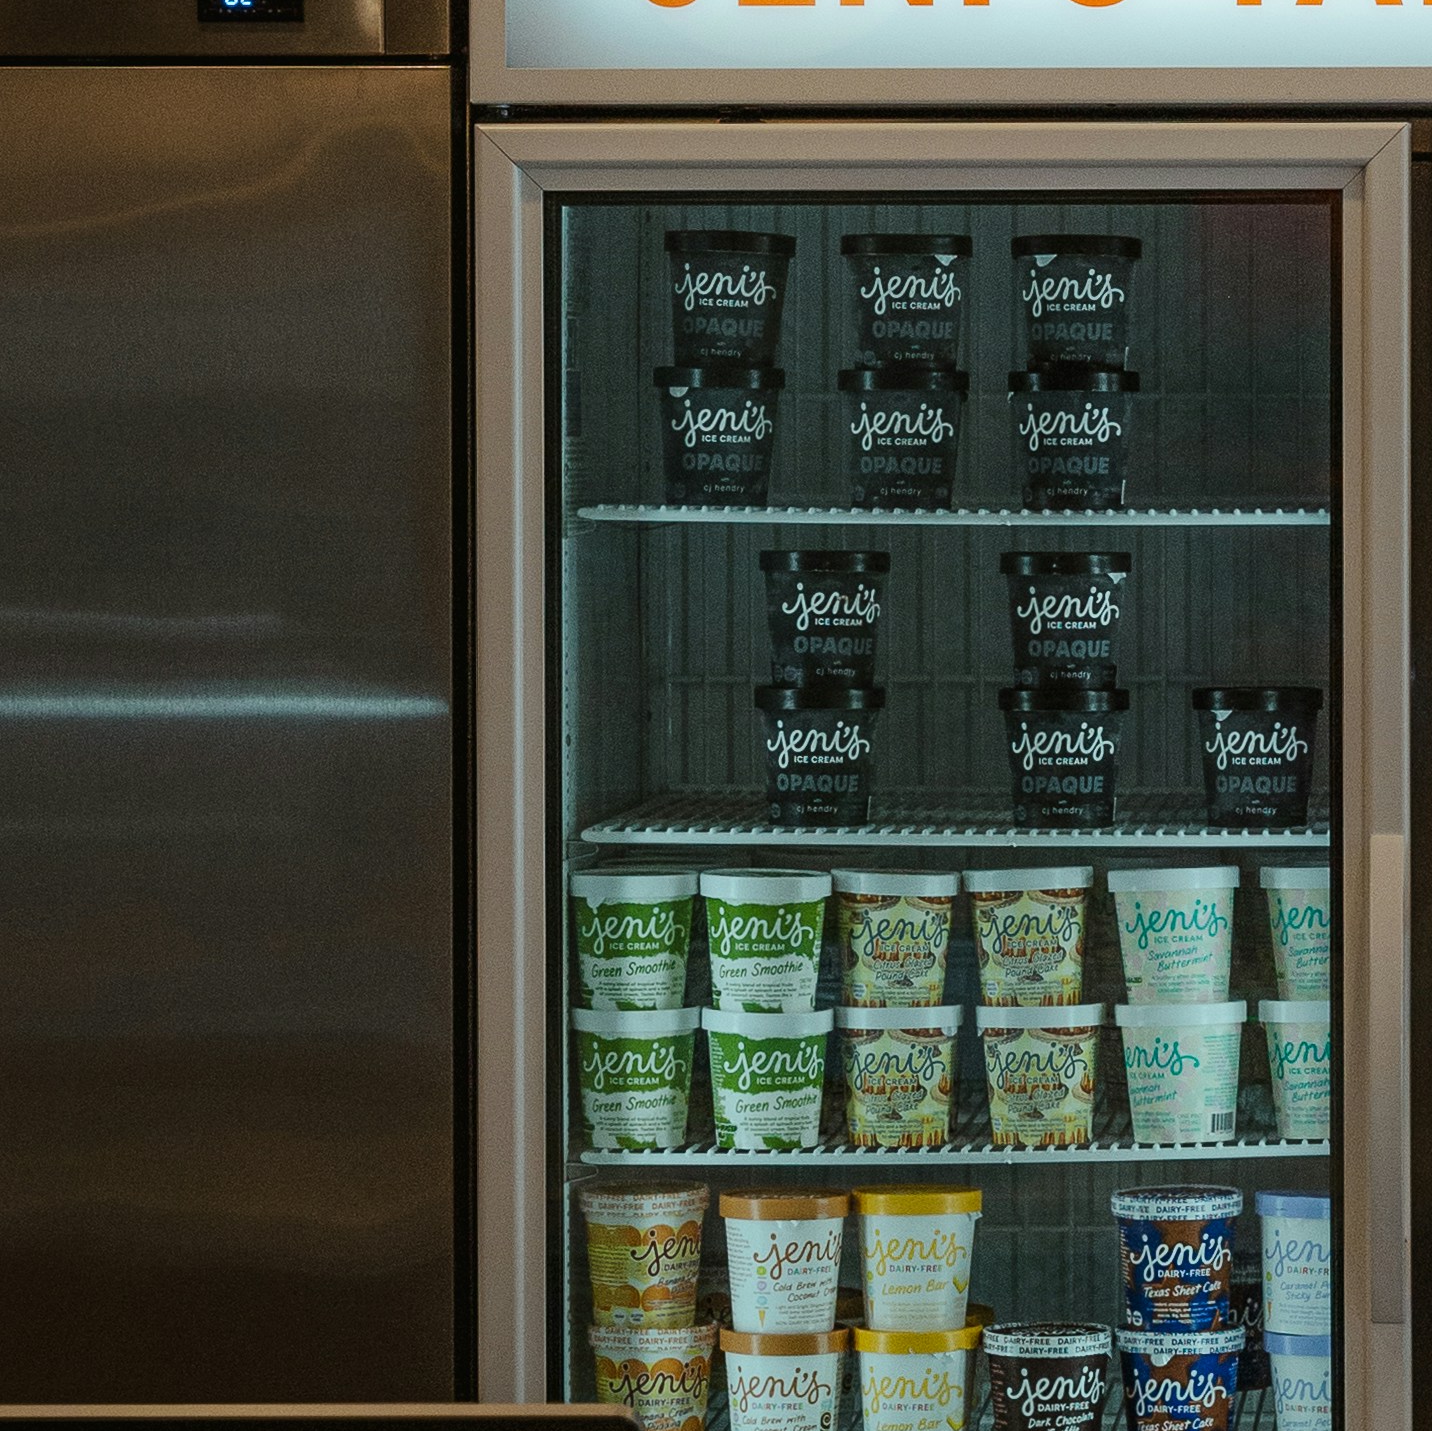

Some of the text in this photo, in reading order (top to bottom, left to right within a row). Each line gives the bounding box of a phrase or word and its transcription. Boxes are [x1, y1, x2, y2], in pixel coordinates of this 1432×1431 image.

[675, 263, 776, 310] jeni's
[699, 299, 749, 307] ICE CREAM
[861, 267, 961, 315] jeni's
[1023, 269, 1124, 318] jeni's
[672, 399, 772, 448] jeni's
[850, 402, 953, 451] jeni's
[1019, 402, 1121, 452] jeni's
[782, 582, 880, 631] jeni's
[1017, 586, 1119, 635] jeni's
[794, 635, 875, 656] OPAQUE
[1028, 639, 1110, 659] OPAQUE
[767, 720, 870, 768] jeni's
[1012, 721, 1115, 771] jeni's
[1206, 721, 1308, 770] jeni's
[777, 774, 858, 794] OPAQUE
[1022, 775, 1103, 795] OPAQUE
[1216, 775, 1297, 795] OPAQUE
[582, 907, 684, 954] jeni's
[711, 907, 814, 955] jeni's
[851, 909, 949, 956] jeni's
[981, 904, 1081, 953] jeni's
[1126, 900, 1227, 950] jeni's
[592, 960, 676, 979] Green Smoothie
[1148, 946, 1198, 962] Savannah
[1157, 952, 1213, 972] Buttermint
[584, 1042, 686, 1089] jeni's
[724, 1042, 824, 1090] jeni's
[851, 1044, 945, 1090] jeni's
[987, 1042, 1088, 1090] jeni's
[1156, 1205, 1206, 1213] DAIRY-FREE
[753, 1233, 841, 1280] jeni's
[865, 1229, 968, 1276] jeni's
[890, 1265, 942, 1273] DAIRY-FREE
[1130, 1233, 1231, 1282] jeni's
[1158, 1268, 1211, 1277] DAIRY-FREE
[882, 1280, 947, 1296] Lemon Bar
[730, 1366, 831, 1413] jeni's
[863, 1367, 963, 1414] jeni's
[1007, 1366, 1104, 1416] jeni's
[1038, 1401, 1090, 1412] DAIRY-FREE
[1127, 1369, 1227, 1417] jeni's
[1148, 1405, 1201, 1413] DAIRY-FREE
[1028, 1411, 1094, 1429] Dark Chocolate
[1162, 1420, 1189, 1431] Sheet
[1192, 1416, 1214, 1429] Cake
